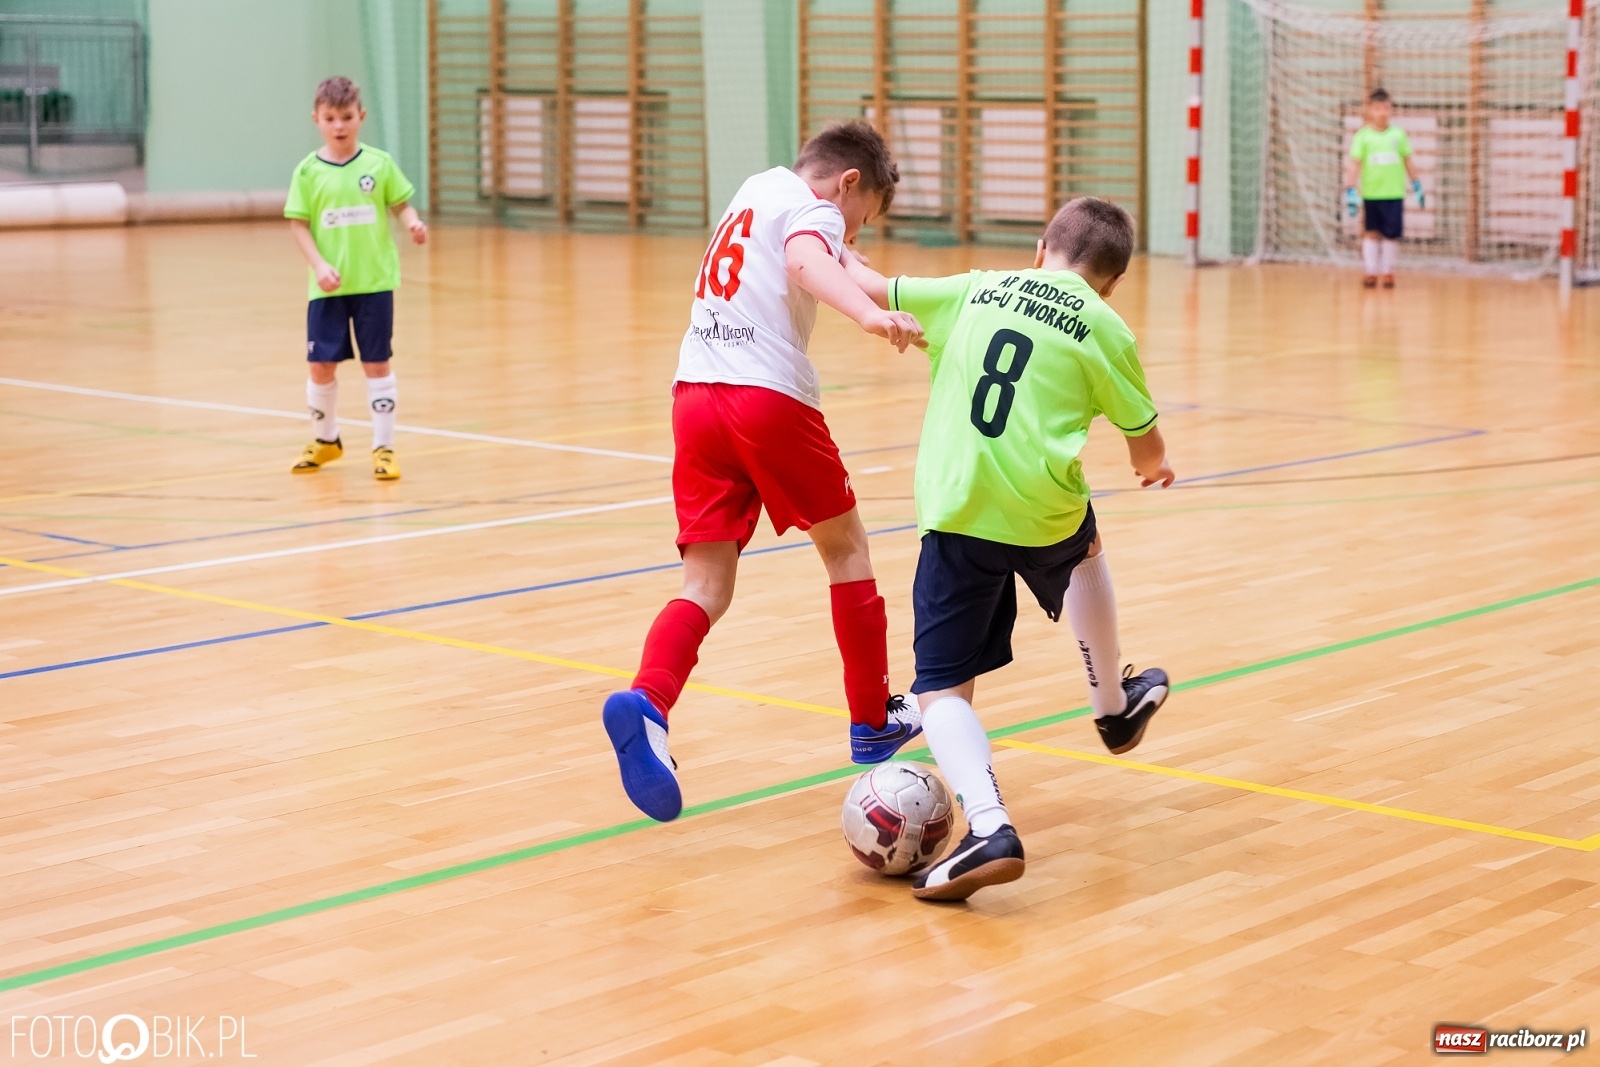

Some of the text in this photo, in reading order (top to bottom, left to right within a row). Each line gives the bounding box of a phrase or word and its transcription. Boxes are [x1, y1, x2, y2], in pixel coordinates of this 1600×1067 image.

[695, 207, 754, 302] 16
[970, 288, 1091, 343] LKS-U TWORKÓW
[998, 275, 1085, 312] AP MŁODEGO
[970, 328, 1034, 439] 8
